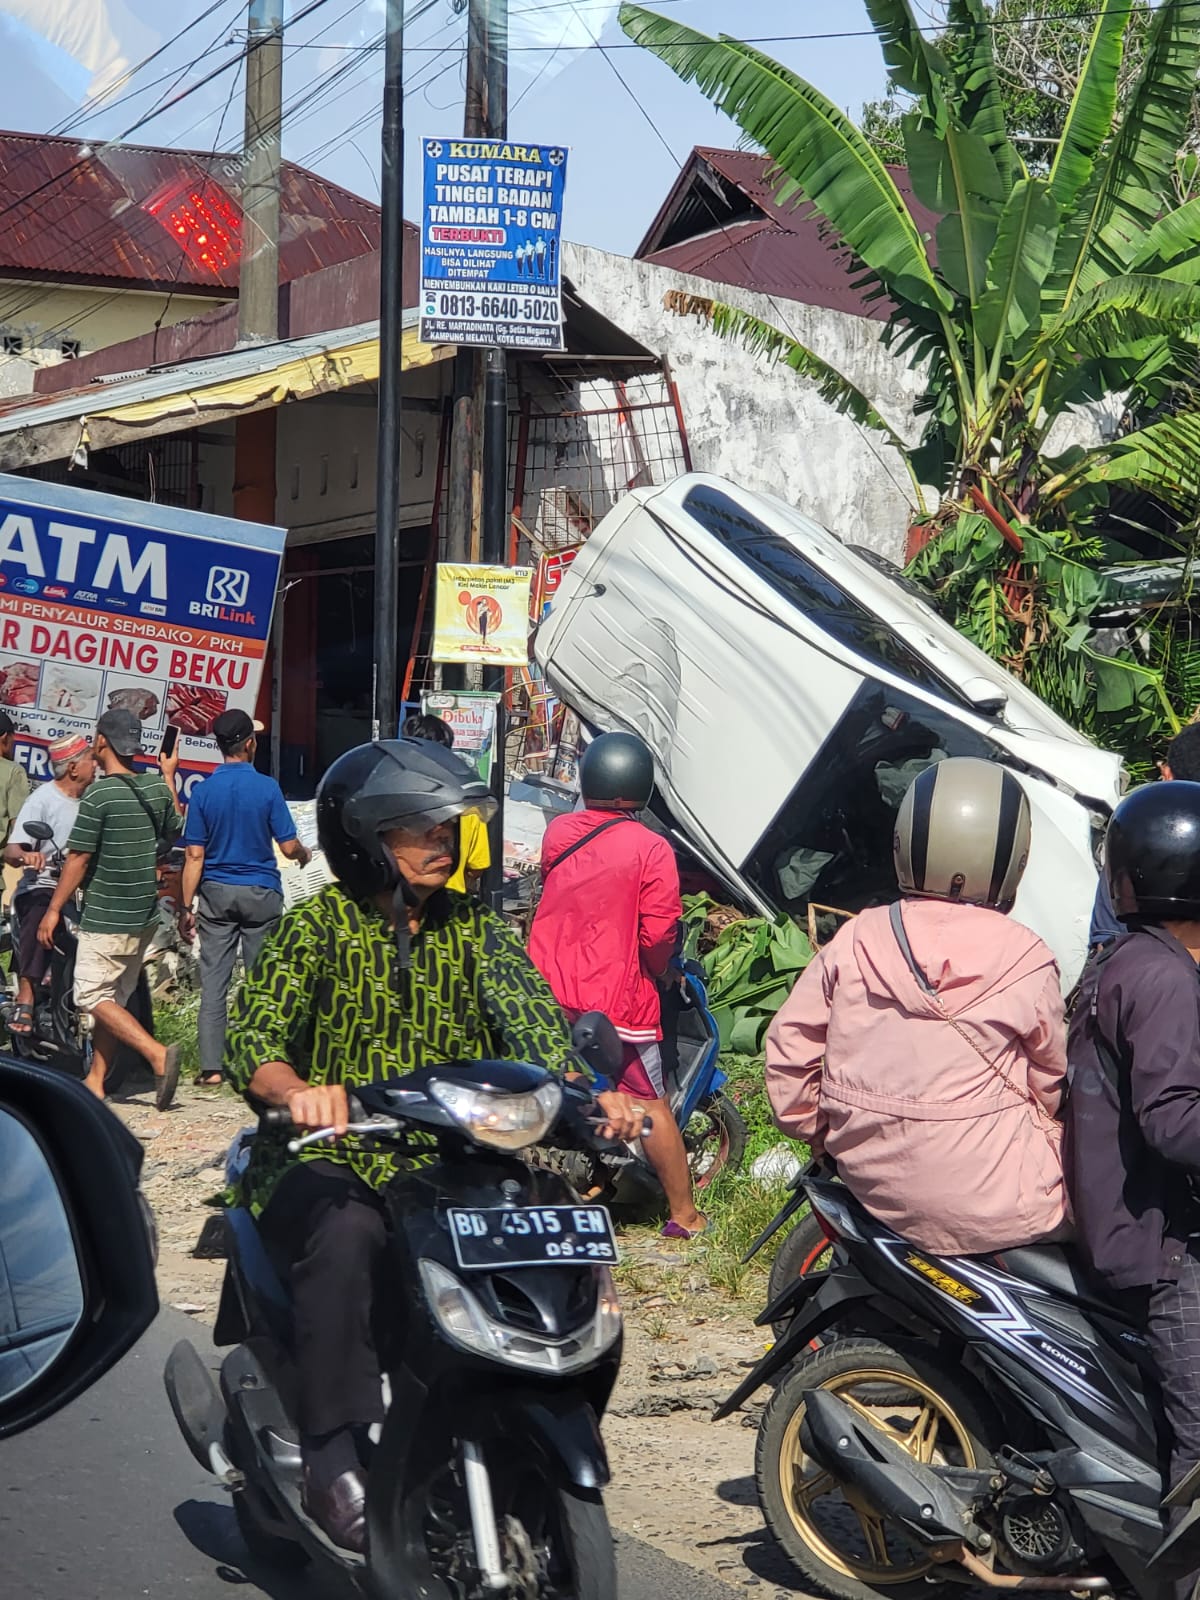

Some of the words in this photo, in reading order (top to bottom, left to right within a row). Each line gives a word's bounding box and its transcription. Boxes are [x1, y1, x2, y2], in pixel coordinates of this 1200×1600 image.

[449, 142, 542, 163] KUMARA
[436, 164, 491, 182] PUSAT
[494, 166, 553, 188] TERAPI
[434, 184, 494, 204] TINGGI
[497, 187, 552, 209] BADAN
[428, 205, 500, 225] TAMBAH
[502, 208, 527, 227] 1-8
[531, 211, 557, 230] CM
[432, 227, 504, 244] TERBUKTI
[424, 247, 466, 257] HASILNYA
[467, 248, 513, 260] LANGSUNG
[441, 258, 461, 267] BISA
[462, 258, 496, 268] DILIHAT
[447, 268, 489, 278] DITEMPAT
[424, 279, 486, 291] MENYEMBUHKAN
[487, 282, 506, 292] KAKI
[551, 287, 557, 297] X
[440, 294, 558, 321] 0813-6640-5020
[448, 321, 494, 333] MARTADINATA
[430, 331, 465, 341] KAMPUNG
[496, 334, 515, 345] KOTA
[515, 335, 552, 346] BENGKULU
[0, 513, 168, 600] ATM
[22, 602, 109, 629] PENYALUR
[113, 619, 192, 643] SEMBAKO
[209, 636, 243, 653] PKH
[30, 625, 159, 674] DAGING
[168, 649, 250, 690] BEKU
[21, 711, 48, 721] paru
[57, 717, 91, 730] Ayam
[453, 1213, 488, 1237] BD
[1040, 1341, 1087, 1375] HONDA
